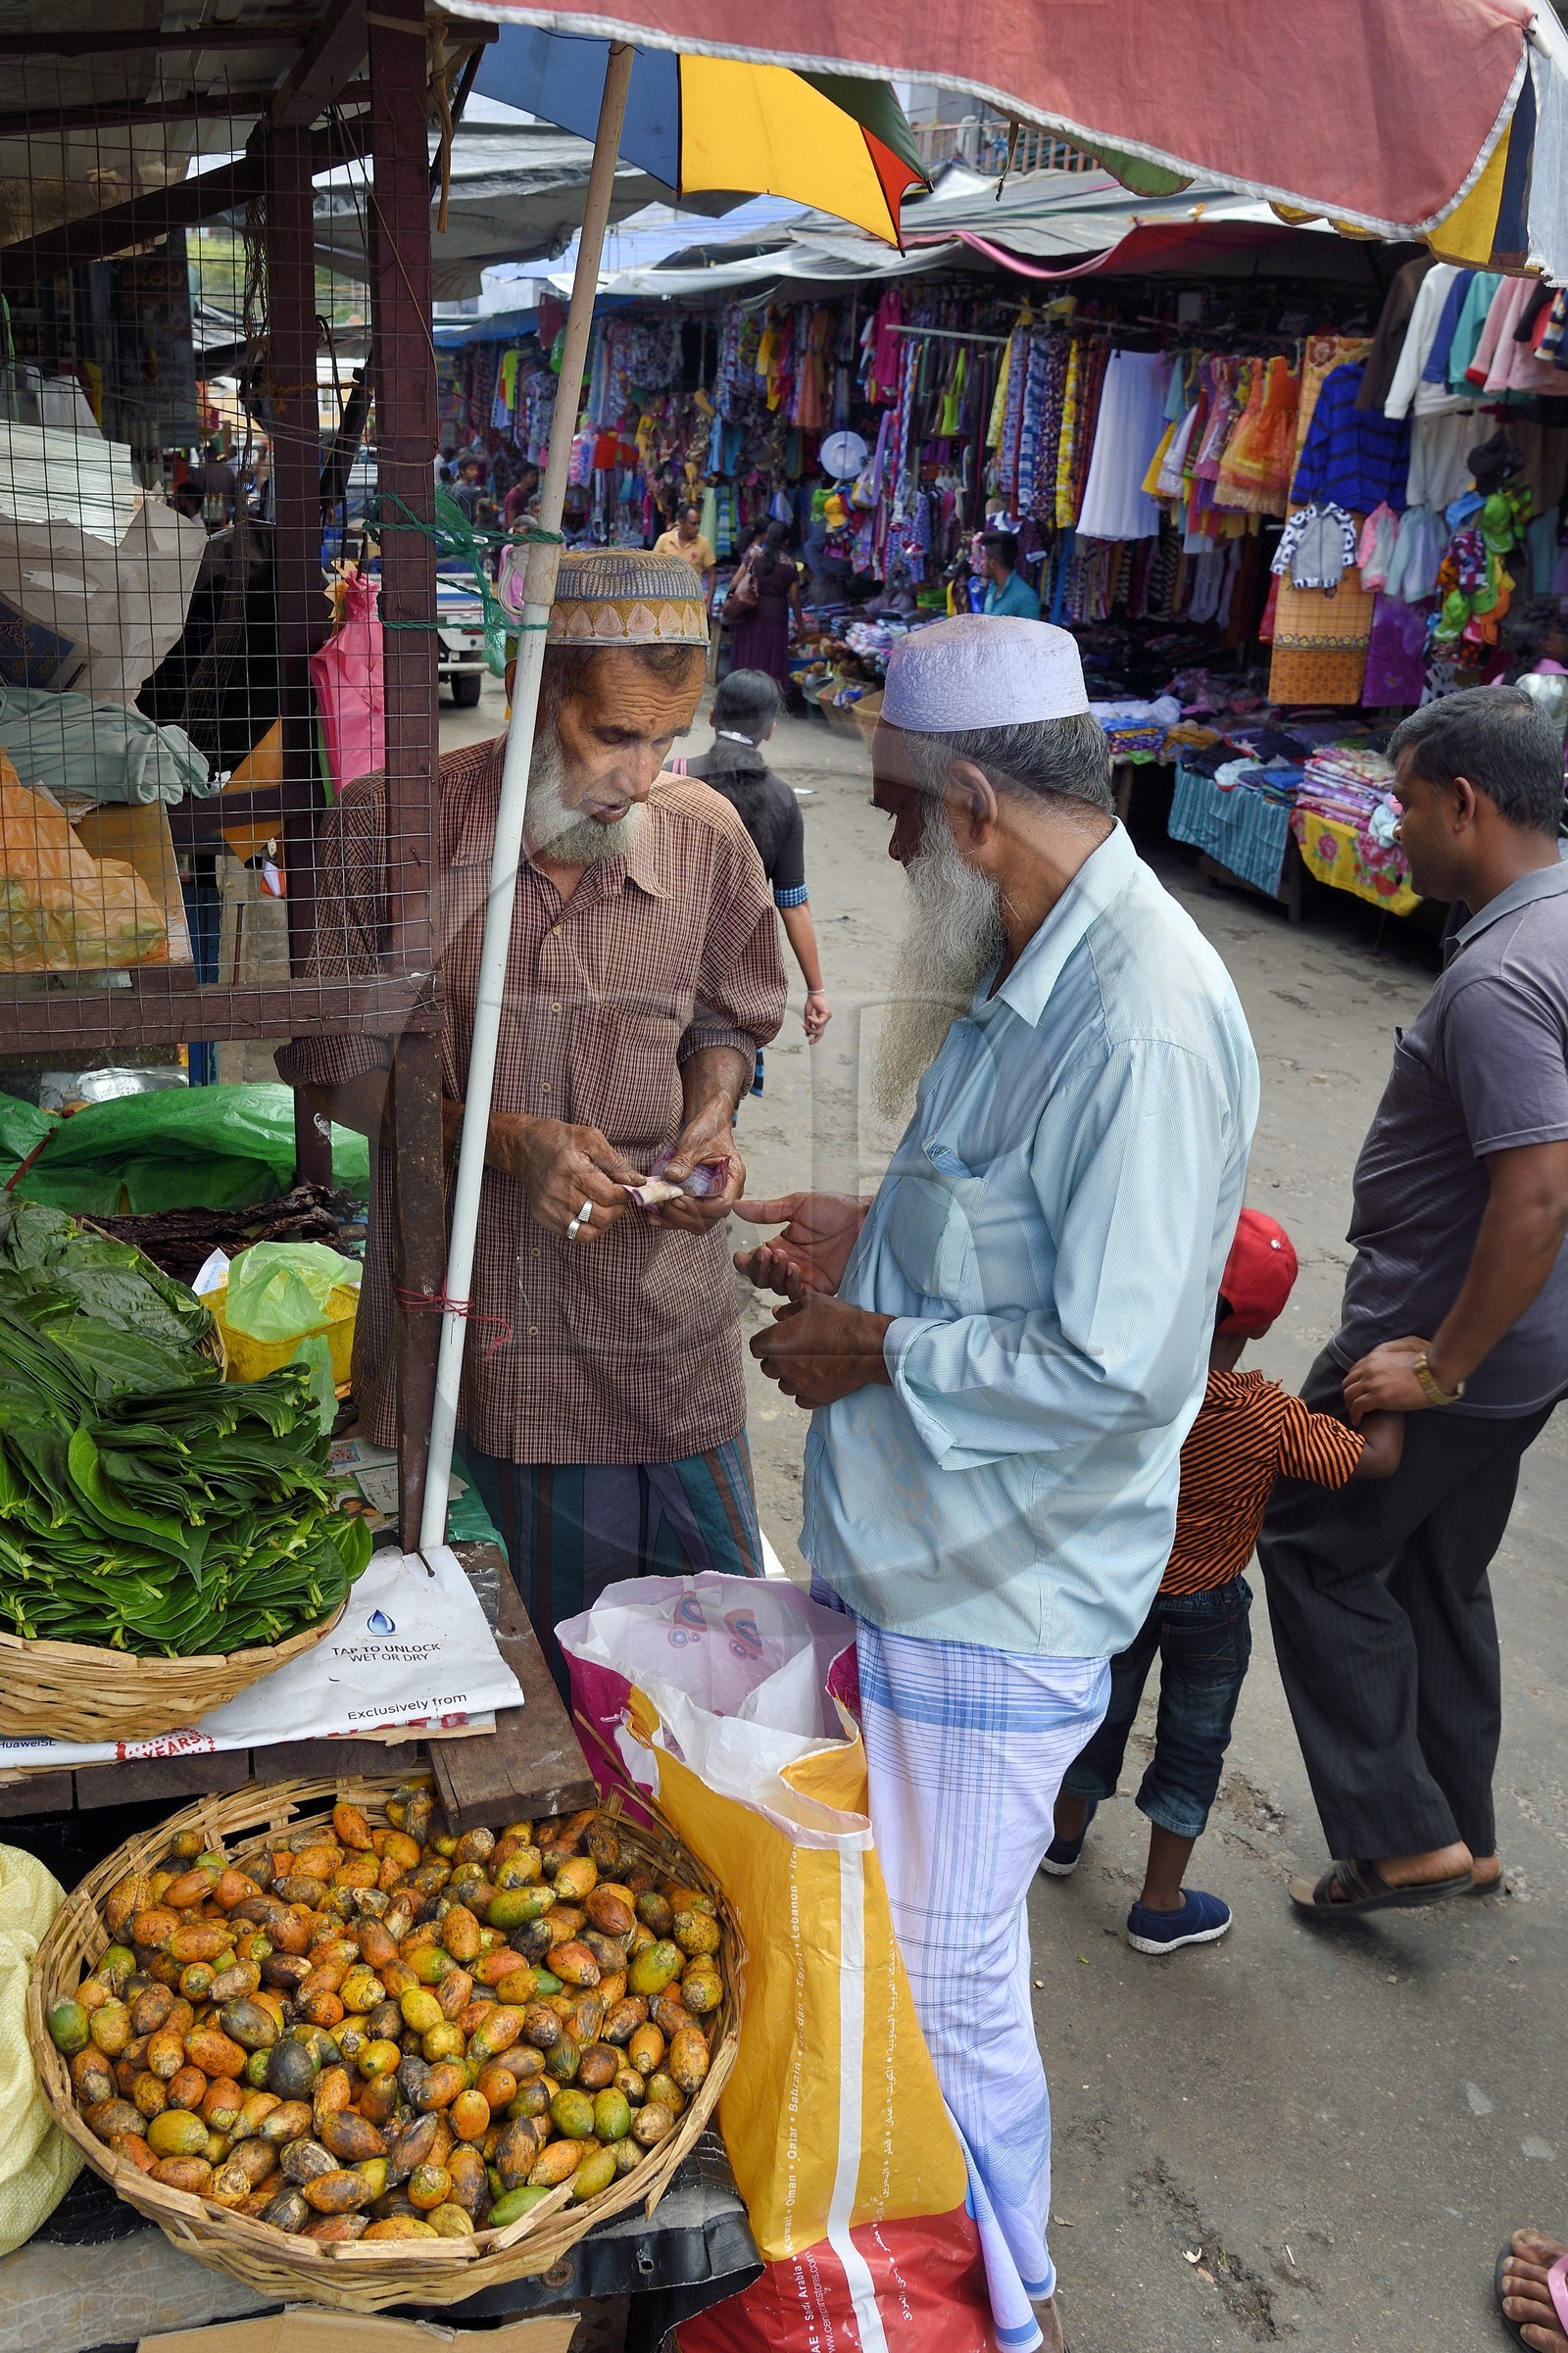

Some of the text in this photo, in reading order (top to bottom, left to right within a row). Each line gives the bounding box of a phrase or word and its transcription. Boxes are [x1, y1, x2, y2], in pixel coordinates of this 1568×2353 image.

[331, 1647, 358, 1656] TAP
[384, 1642, 441, 1653] UNLOCK
[350, 1653, 377, 1662] WET
[404, 1653, 429, 1662] DRY
[347, 1692, 467, 1721] Exclusively from
[790, 1885, 801, 1939] Lebanon
[795, 1951, 806, 1987] Egypt
[796, 2002, 805, 2047] Jordan
[885, 2014, 898, 2055] السعودية
[788, 2062, 802, 2113] Bahrain
[885, 2066, 897, 2095] الكويت
[787, 2126, 798, 2160] Qatar
[786, 2175, 797, 2207] Oman
[783, 2214, 795, 2253] Kuwait
[874, 2230, 892, 2254] مصر
[794, 2265, 808, 2298] Arabia
